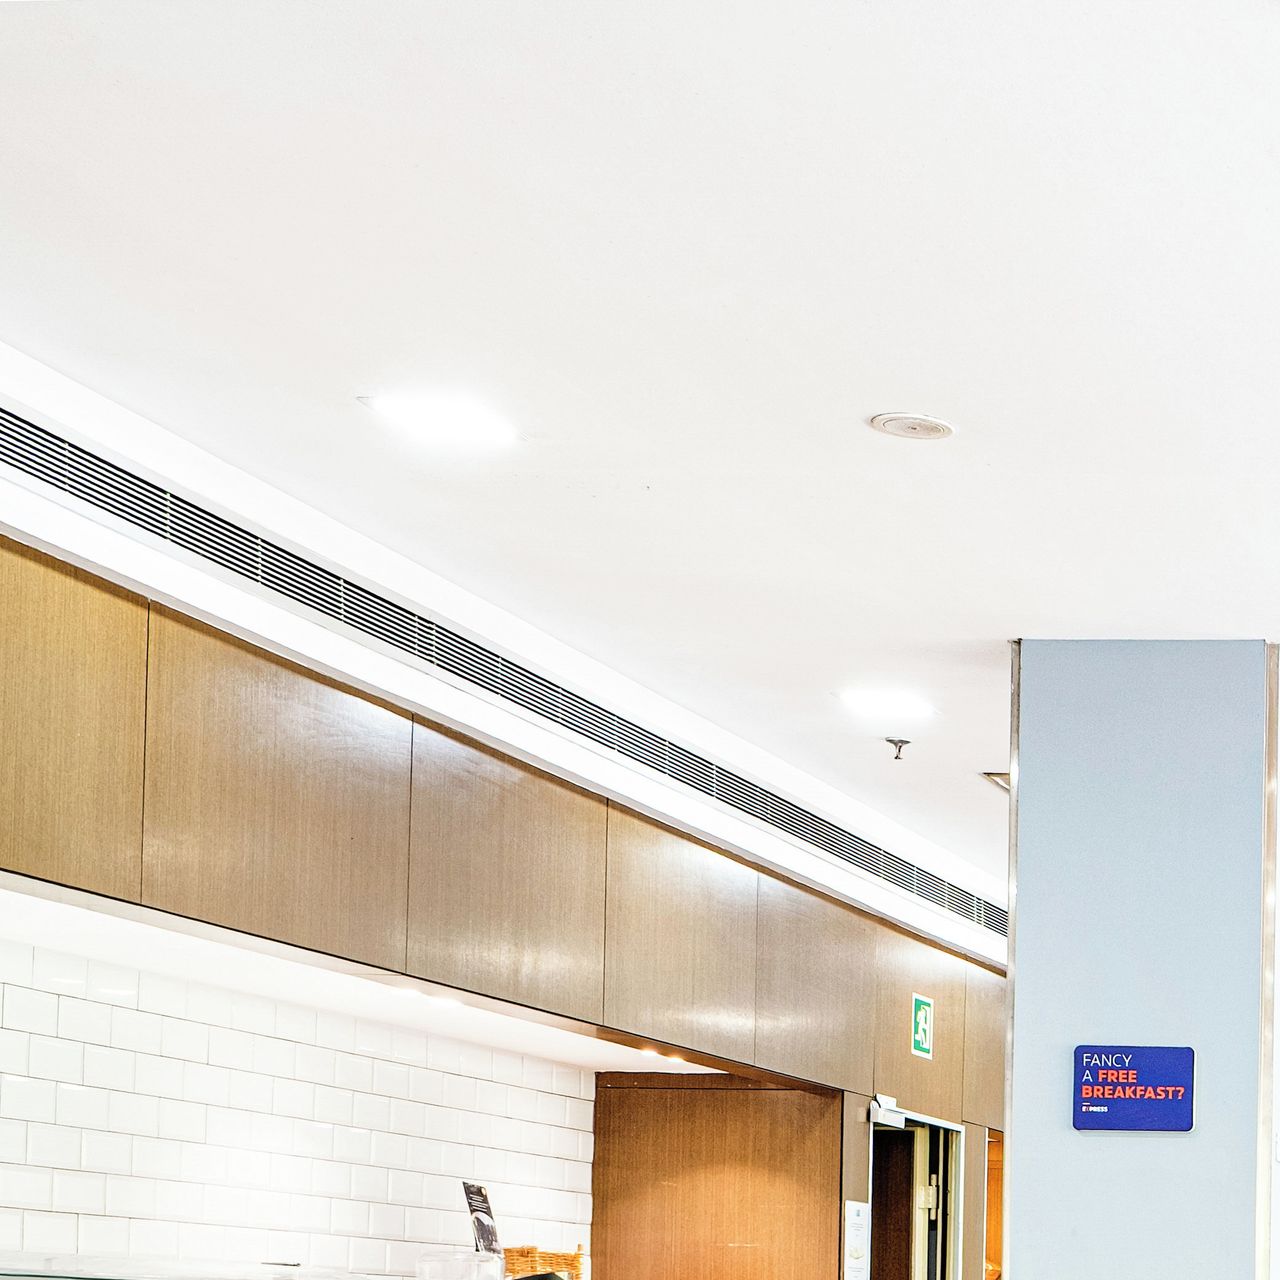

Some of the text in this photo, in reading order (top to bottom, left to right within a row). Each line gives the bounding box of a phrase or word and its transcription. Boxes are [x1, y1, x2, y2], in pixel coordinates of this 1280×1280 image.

[1082, 1053, 1132, 1067] FANCY
[1082, 1070, 1137, 1082] A FREE
[1081, 1085, 1184, 1099] BREAKFAST?
